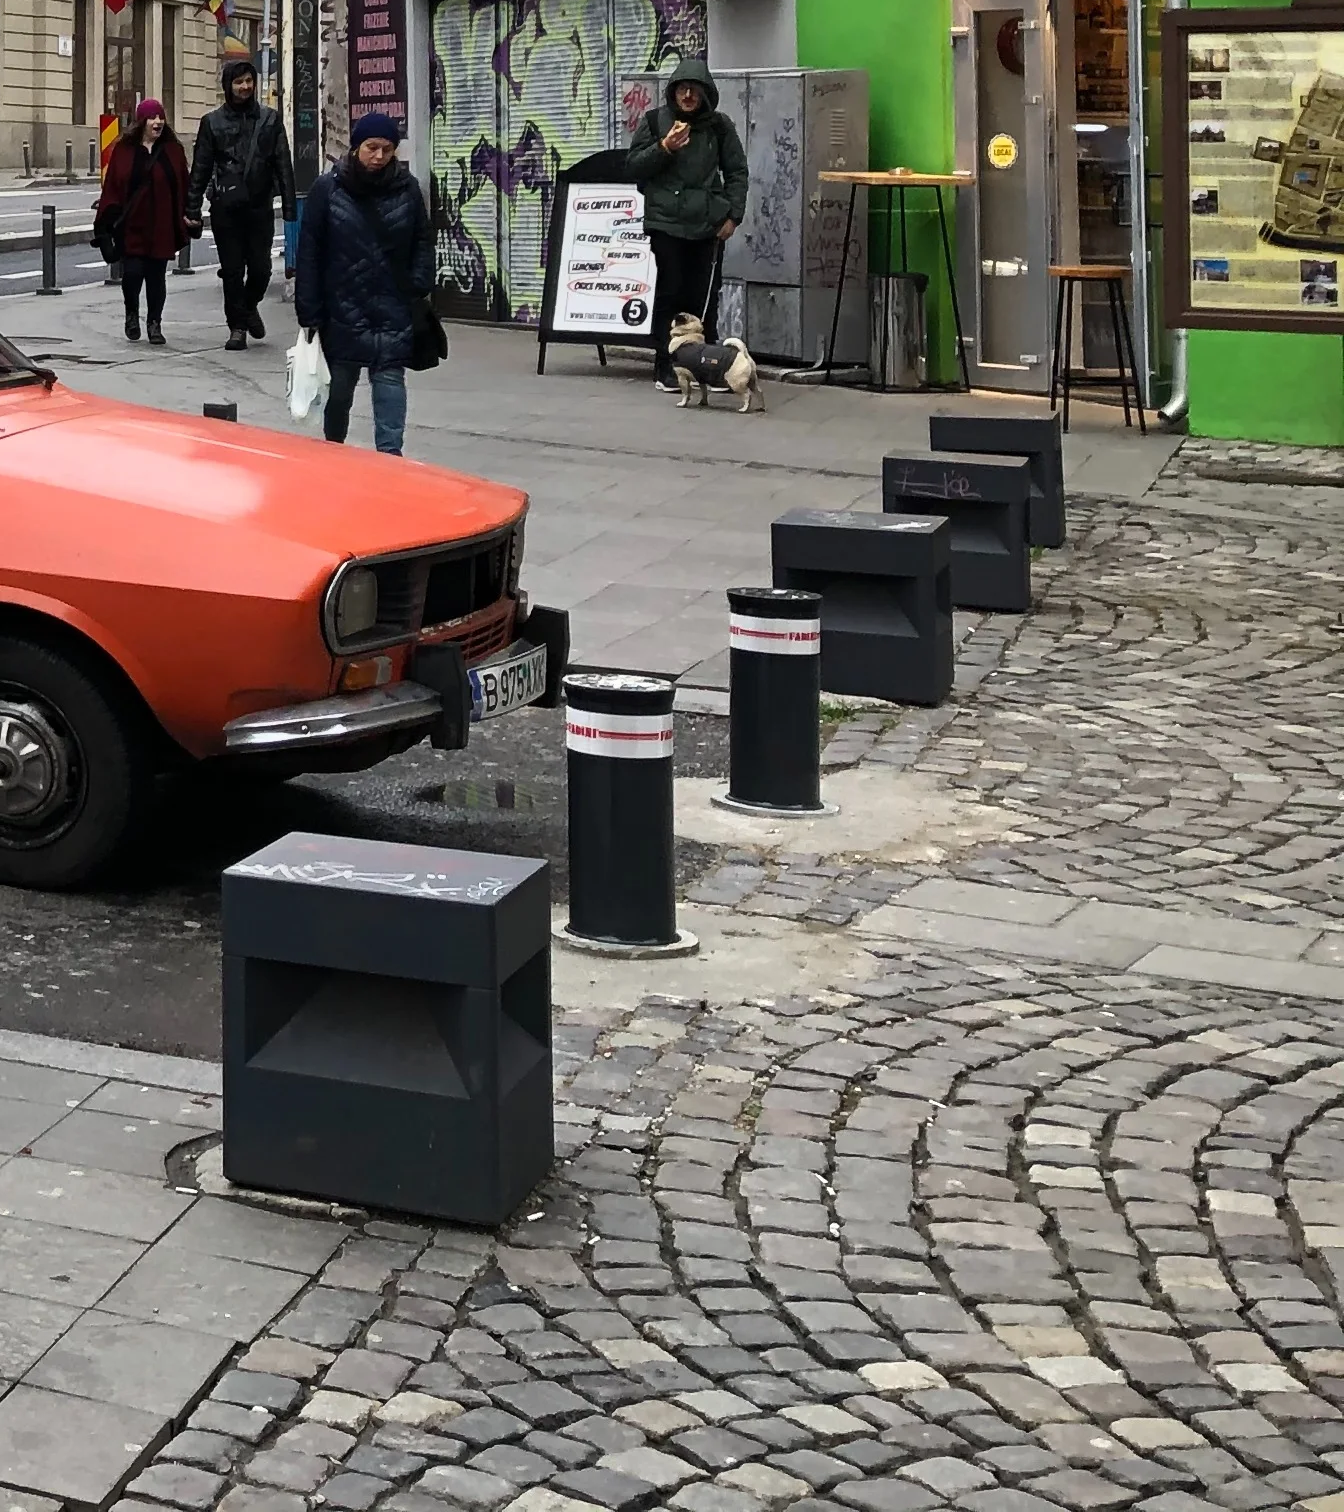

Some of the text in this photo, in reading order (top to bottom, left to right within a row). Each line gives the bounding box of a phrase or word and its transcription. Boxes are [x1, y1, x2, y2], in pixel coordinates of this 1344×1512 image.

[576, 201, 590, 211] BIG
[587, 234, 612, 244] COFFEE
[619, 231, 648, 241] COOKIES
[628, 300, 642, 320] 5
